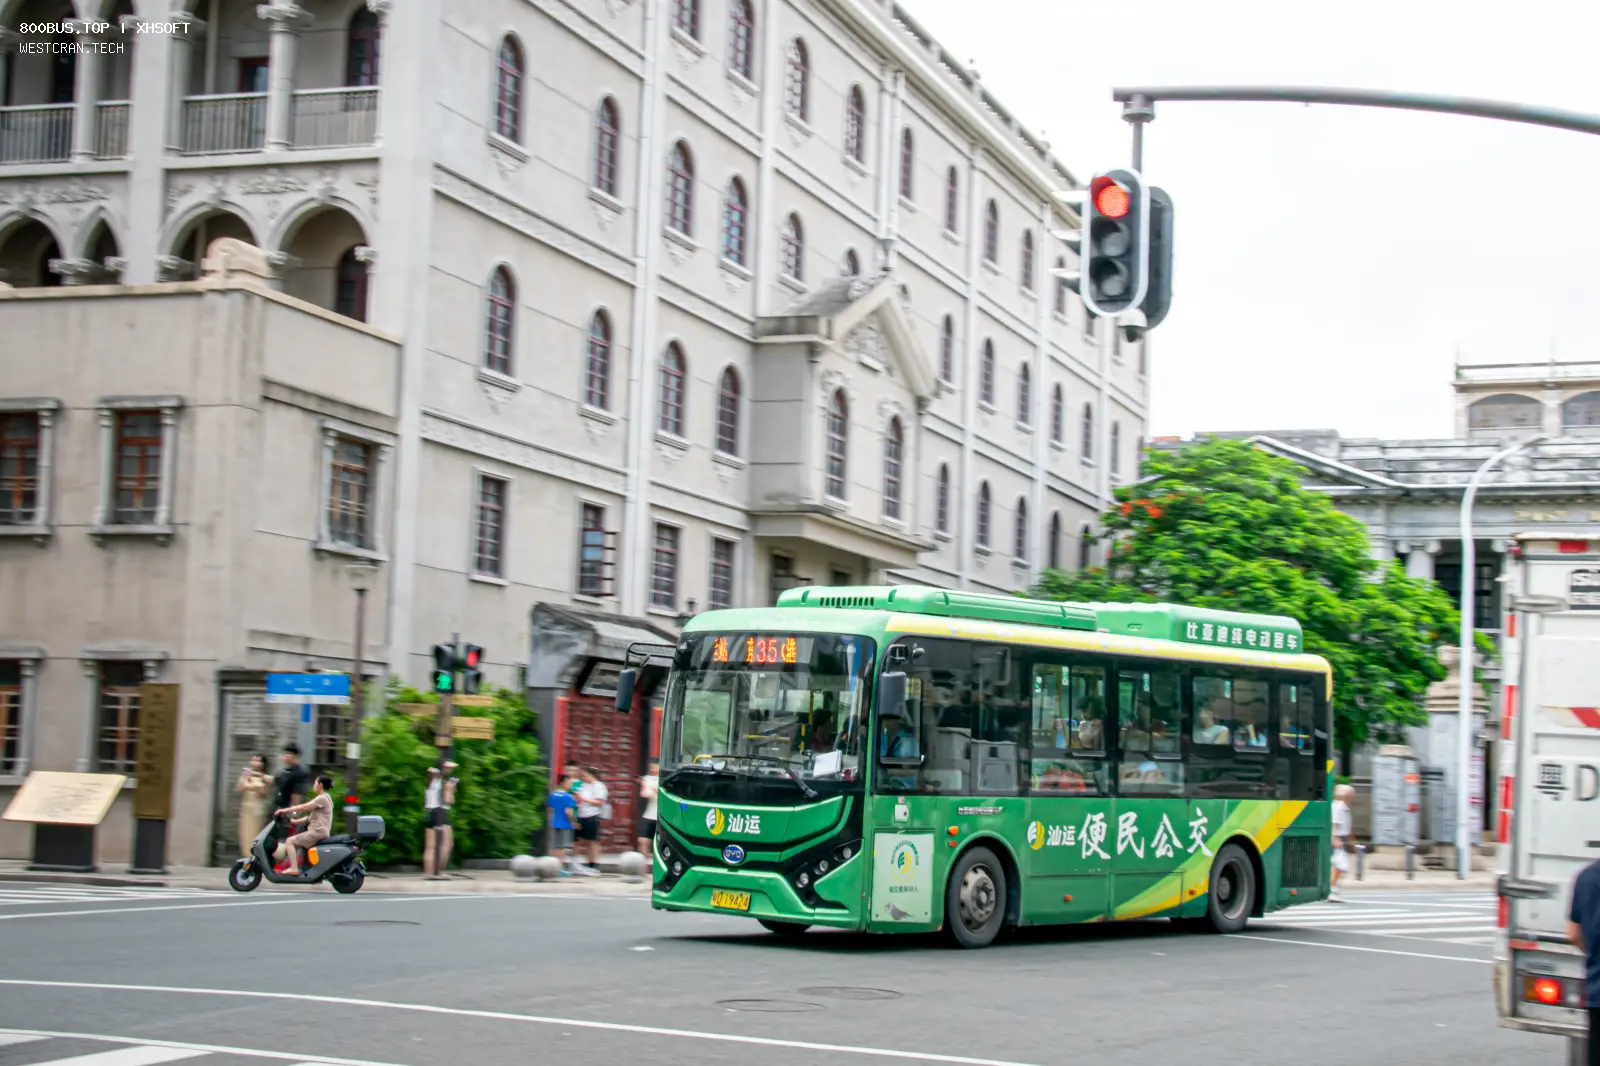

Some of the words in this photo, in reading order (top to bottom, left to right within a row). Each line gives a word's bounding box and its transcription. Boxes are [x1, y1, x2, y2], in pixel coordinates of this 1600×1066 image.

[727, 813, 761, 835] 汕运
[1078, 807, 1213, 860] 便民公交
